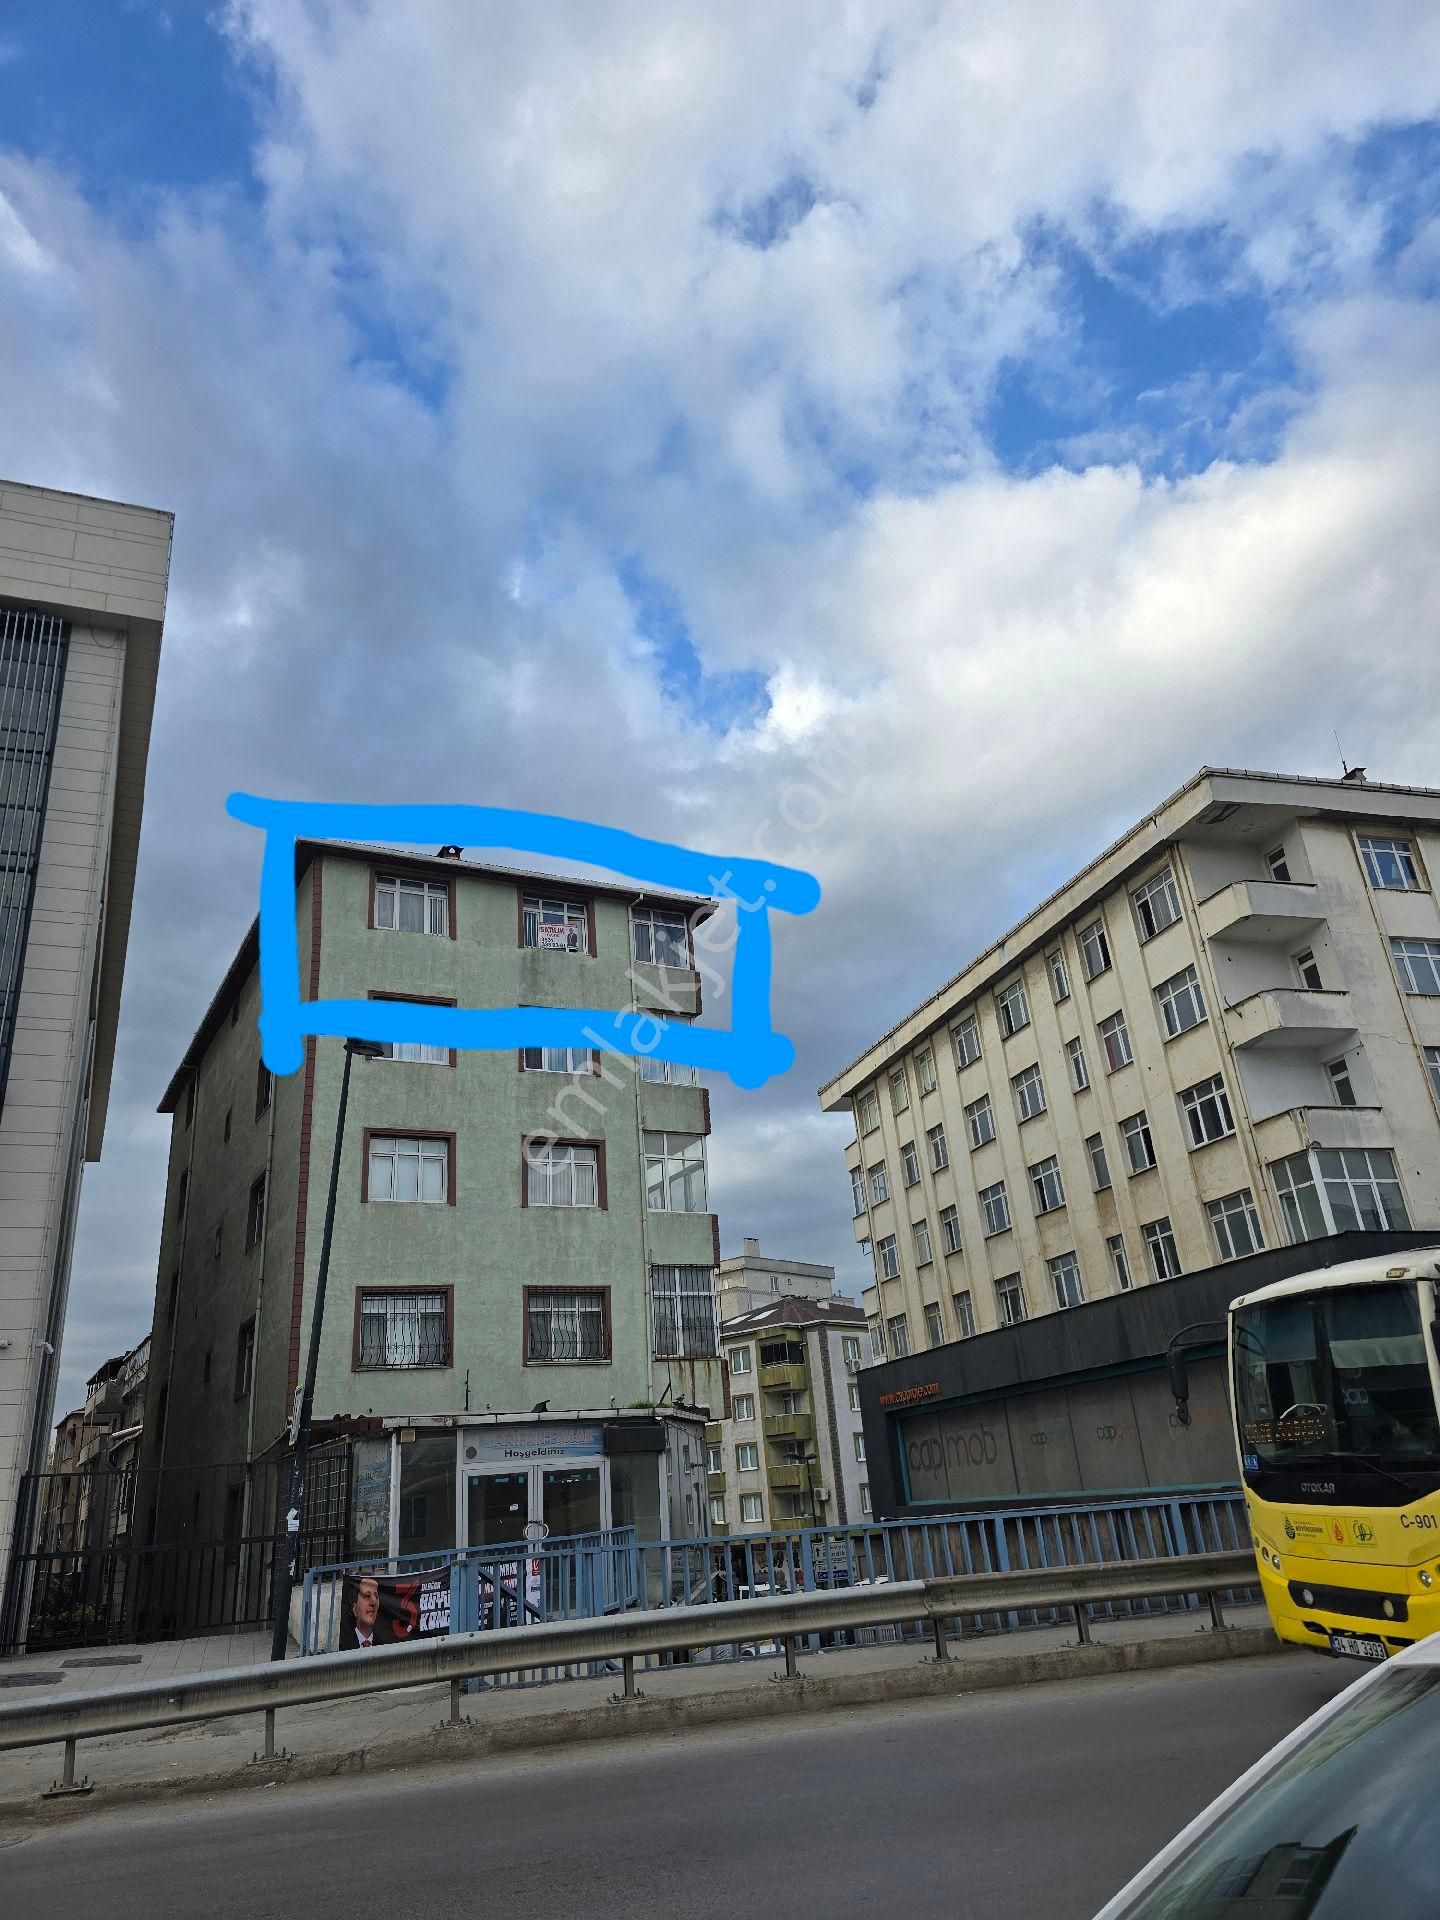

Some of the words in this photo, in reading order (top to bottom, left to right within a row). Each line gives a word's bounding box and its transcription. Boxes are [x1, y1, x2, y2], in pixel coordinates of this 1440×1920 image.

[504, 1448, 565, 1460] Hoşgeldiniz
[1301, 1482, 1336, 1494] OTOKAR
[1400, 1513, 1438, 1529] C-901
[1334, 1636, 1346, 1651] 34
[1360, 1640, 1385, 1658] 3393
